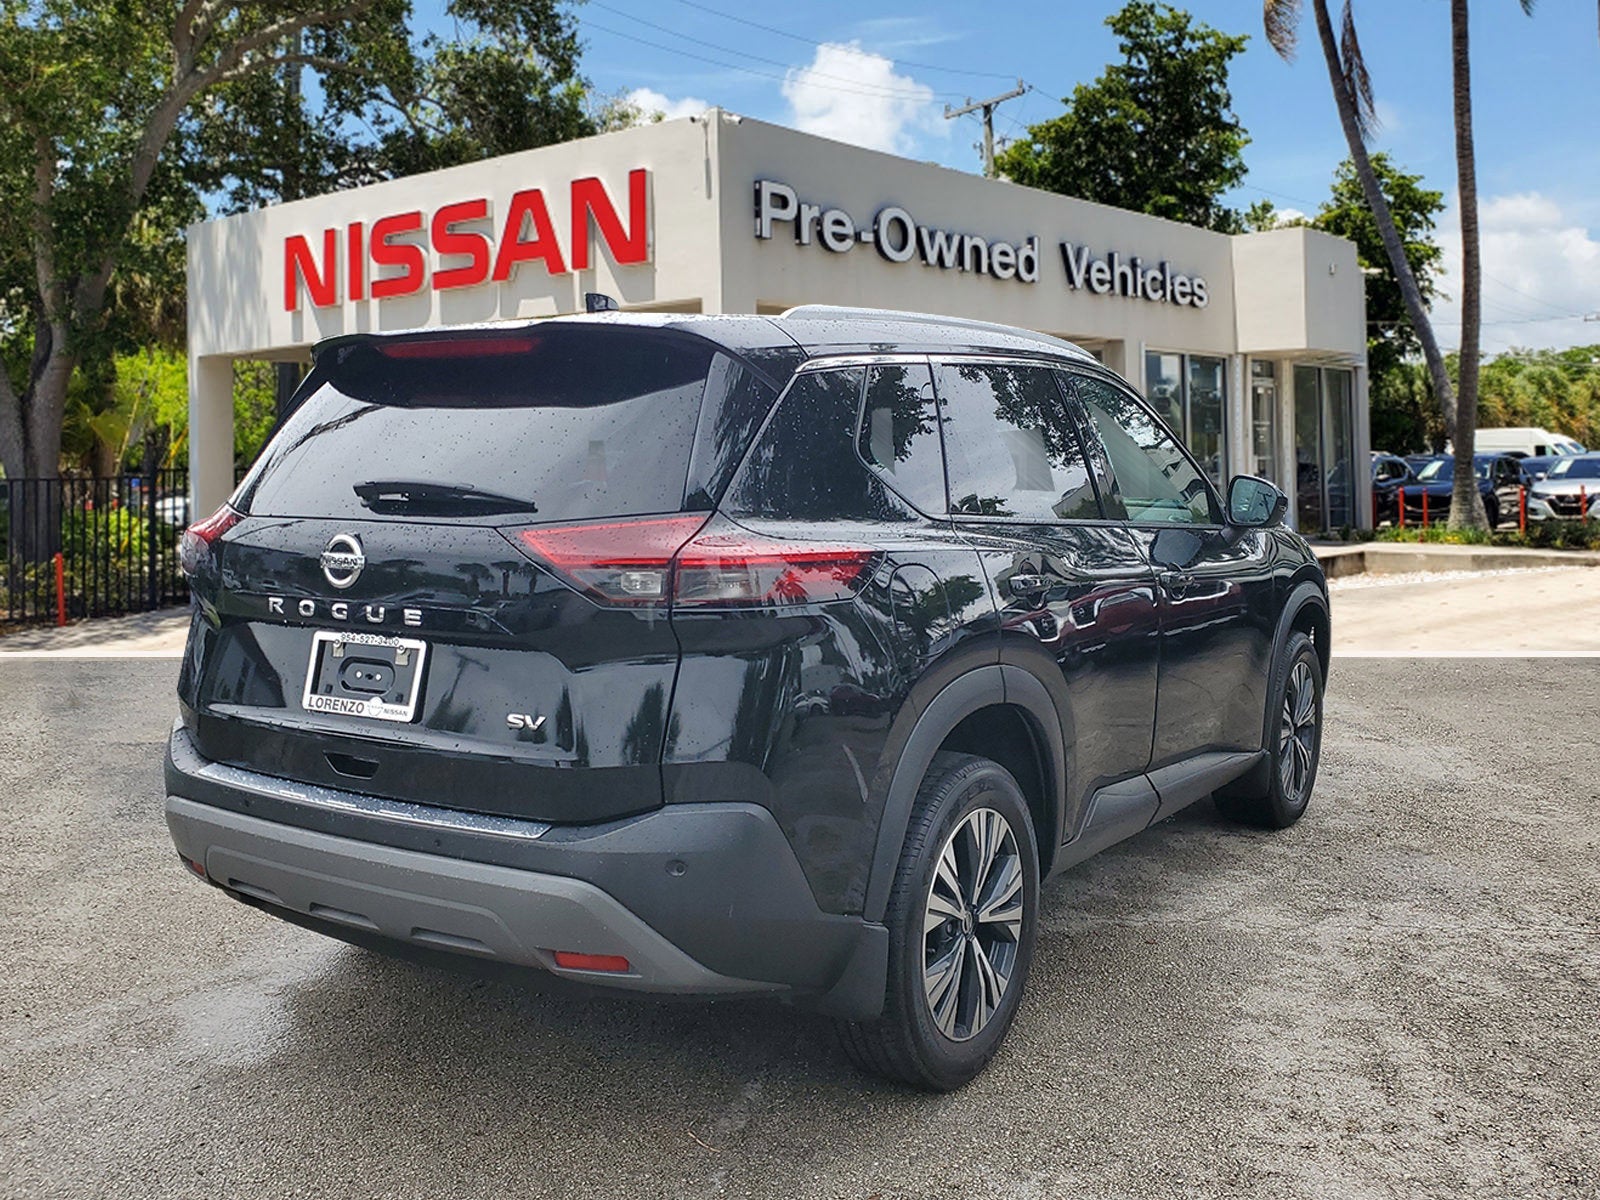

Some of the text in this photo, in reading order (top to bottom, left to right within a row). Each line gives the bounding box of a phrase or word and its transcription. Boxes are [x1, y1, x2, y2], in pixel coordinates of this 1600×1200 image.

[284, 168, 648, 312] NISSAN
[754, 180, 1209, 309] Pre-Owned Vehicles
[323, 556, 359, 567] NISSAN
[268, 596, 423, 627] ROGUE
[340, 632, 400, 646] 954-527-3400
[307, 695, 365, 714] LORENZO
[383, 707, 409, 718] NISSAN
[506, 712, 547, 732] SV
